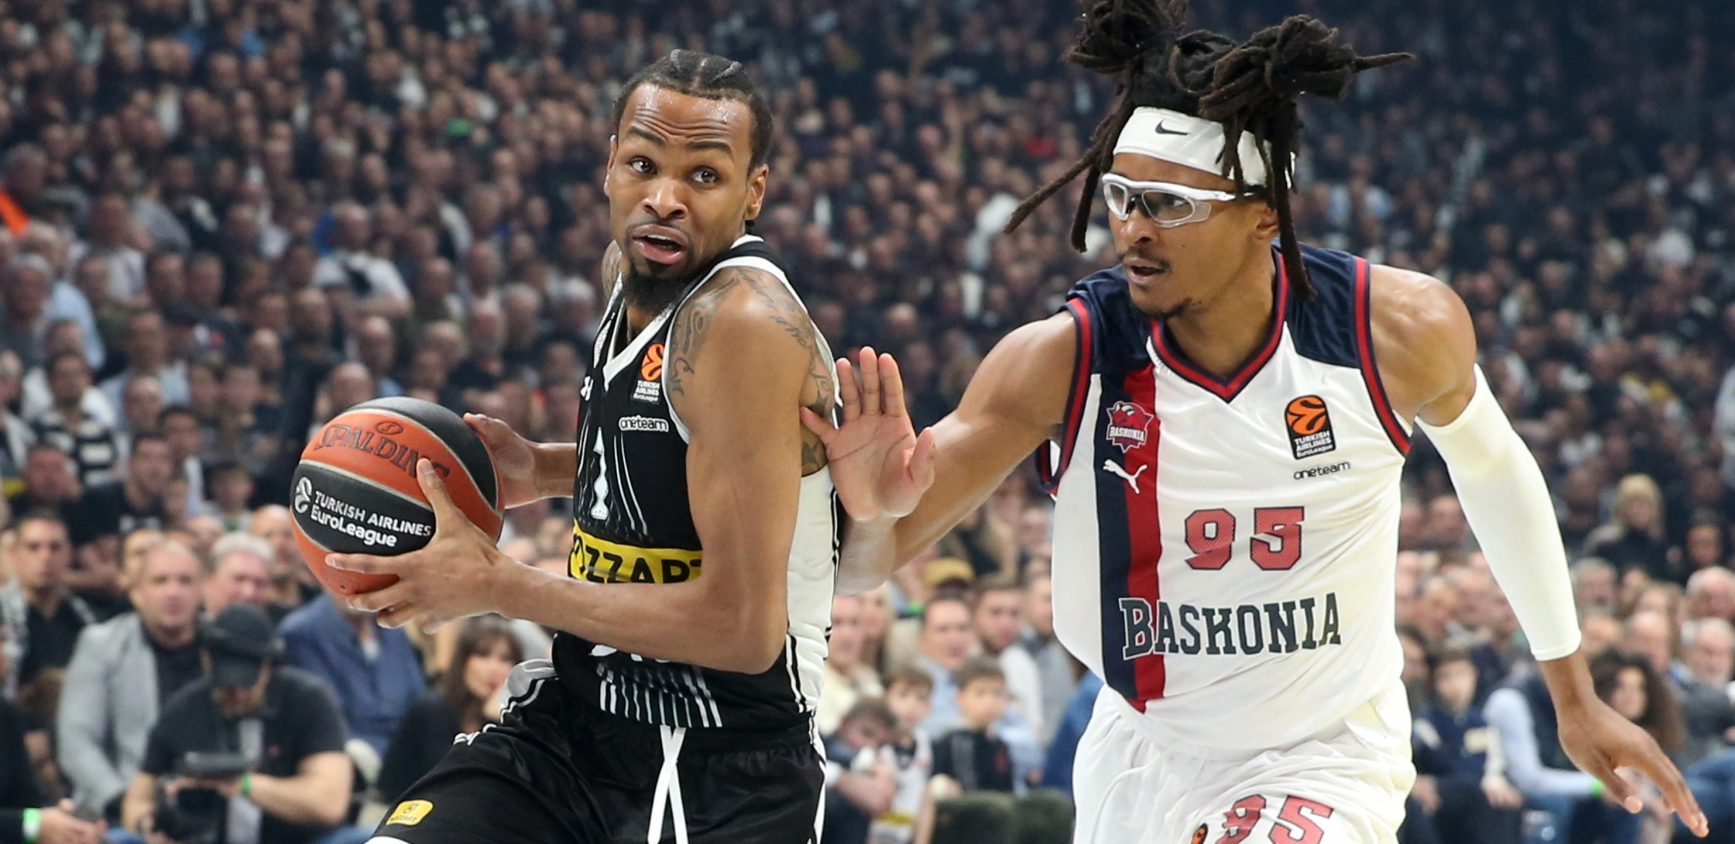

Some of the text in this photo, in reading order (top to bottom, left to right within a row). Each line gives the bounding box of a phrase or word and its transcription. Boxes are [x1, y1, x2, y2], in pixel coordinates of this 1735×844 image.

[620, 416, 668, 431] oneteam
[1109, 426, 1145, 441] BASKONIA
[1294, 430, 1331, 446] TURKISH
[1296, 437, 1332, 452] AIRLINES
[1293, 461, 1351, 480] oneteam
[310, 505, 398, 547] EuroLeague
[314, 490, 432, 538] TURKISH AIRLINES
[1184, 506, 1305, 571] 95
[1118, 591, 1342, 660] BASKONIA
[1214, 793, 1335, 844] 95
